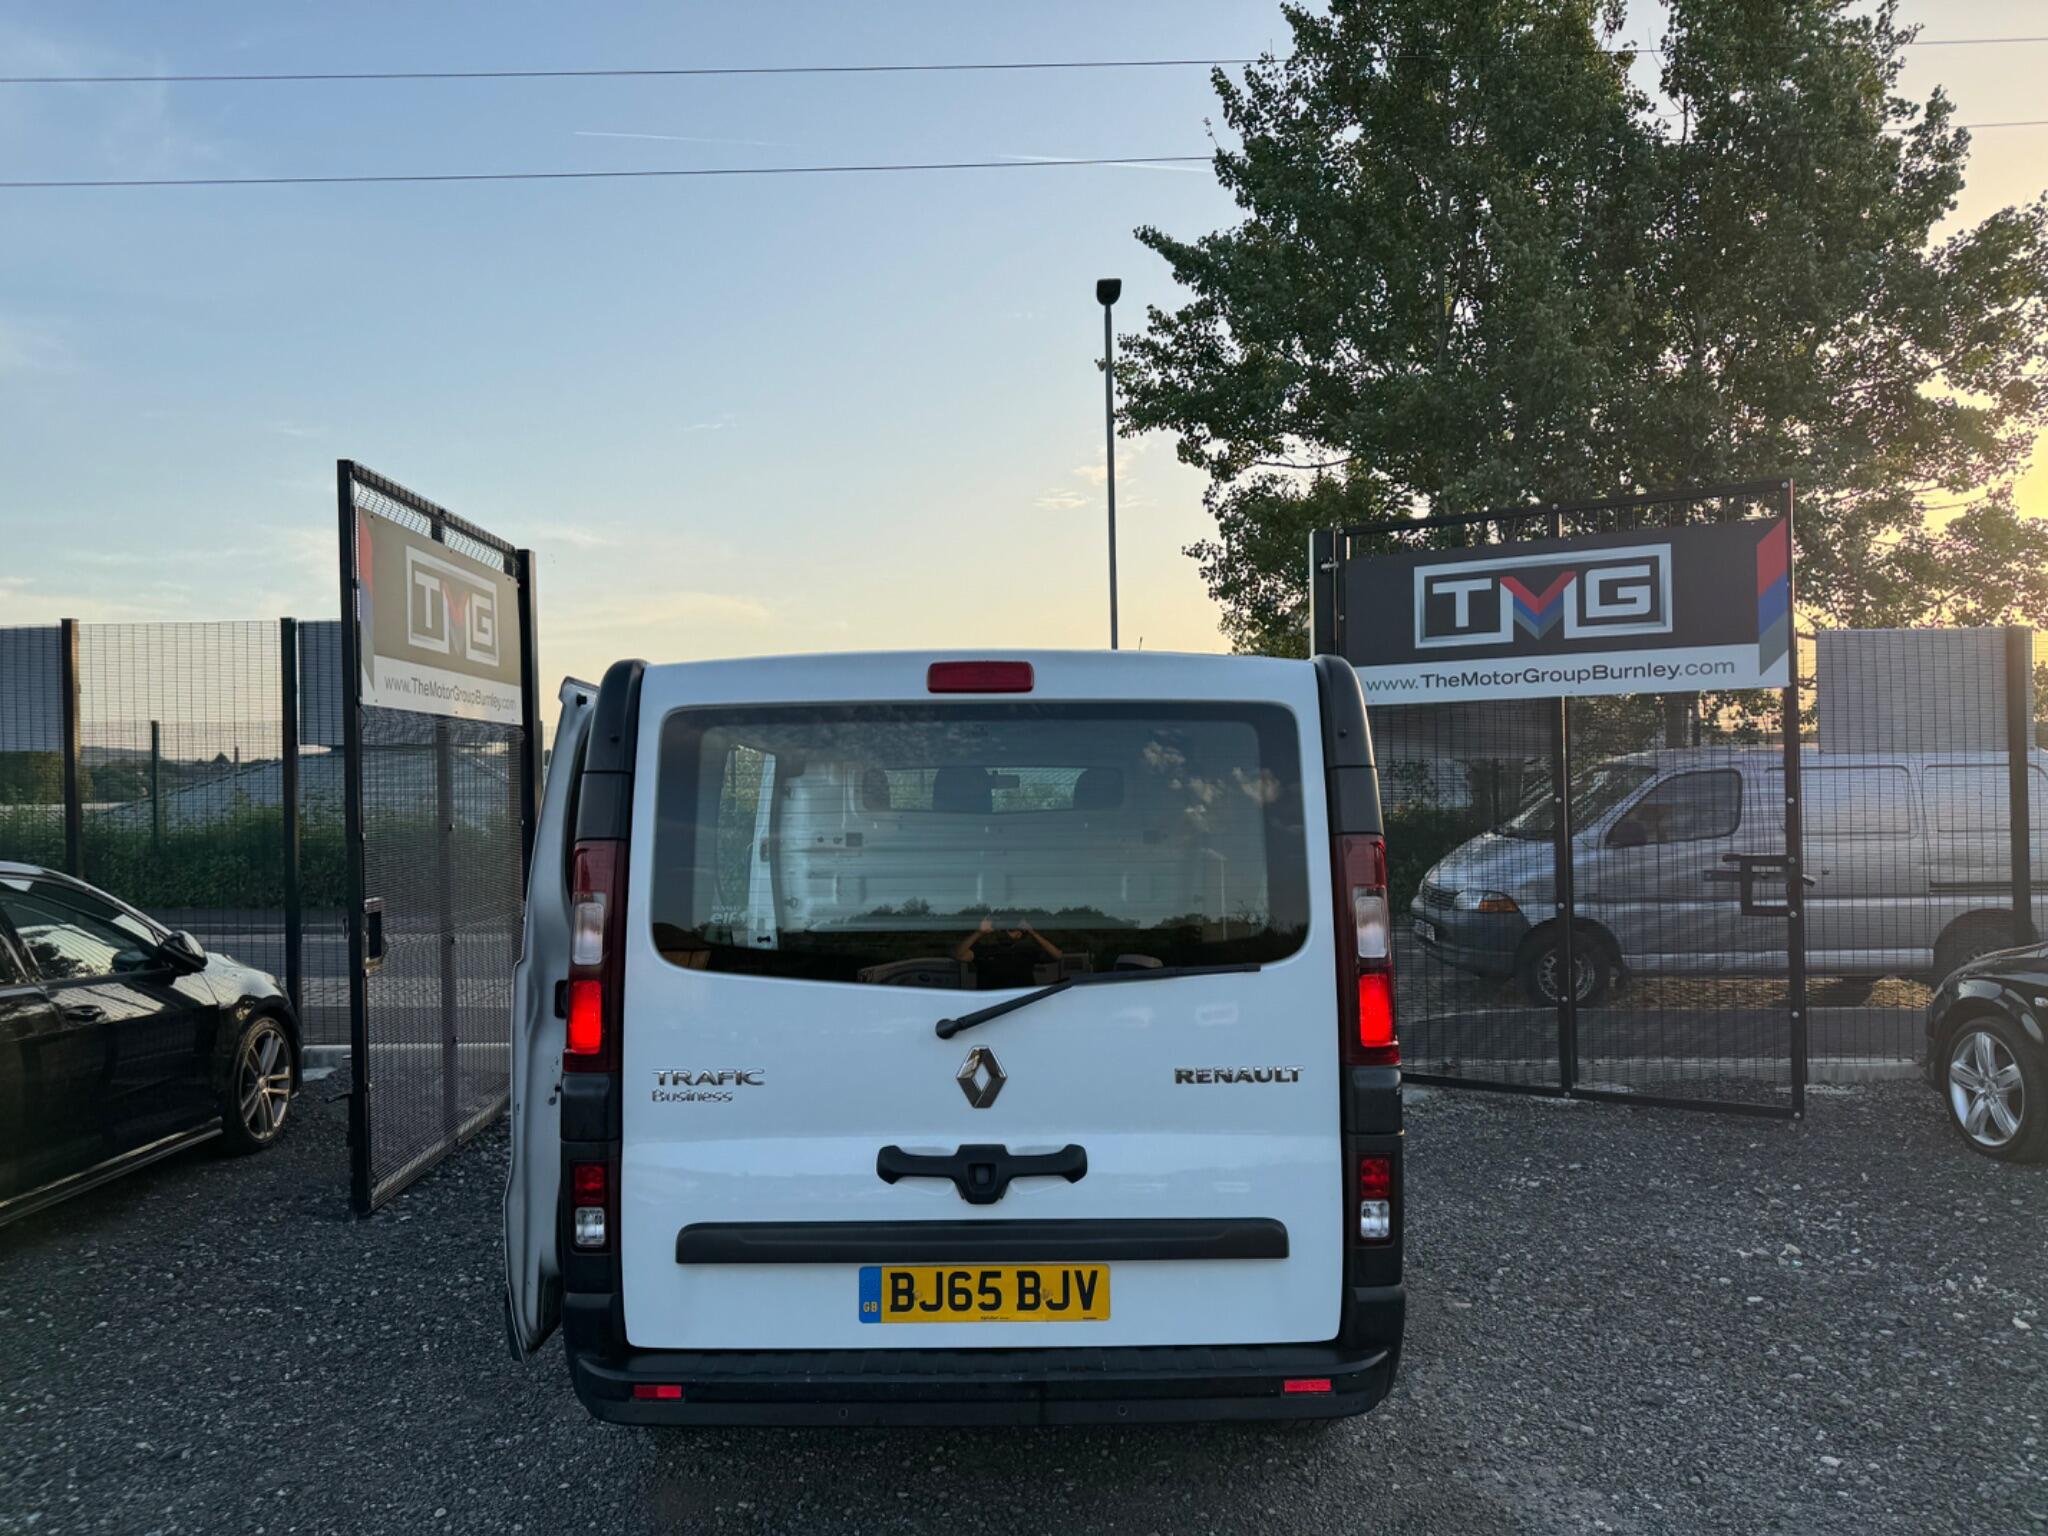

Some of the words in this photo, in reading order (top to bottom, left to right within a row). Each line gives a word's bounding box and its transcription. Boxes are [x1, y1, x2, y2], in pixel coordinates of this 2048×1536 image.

[1425, 556, 1662, 643] TMG
[1366, 658, 1735, 691] www.TheMotorGroupBurnley.com
[385, 675, 516, 711] www.TheMotorGroupBurnley.com
[653, 1070, 765, 1086] TRAFIC
[1174, 1066, 1304, 1084] RENAULT
[652, 1090, 733, 1102] Business
[890, 1271, 1002, 1313] BJ65
[1017, 1270, 1098, 1311] BJV
[863, 1301, 878, 1313] GB
